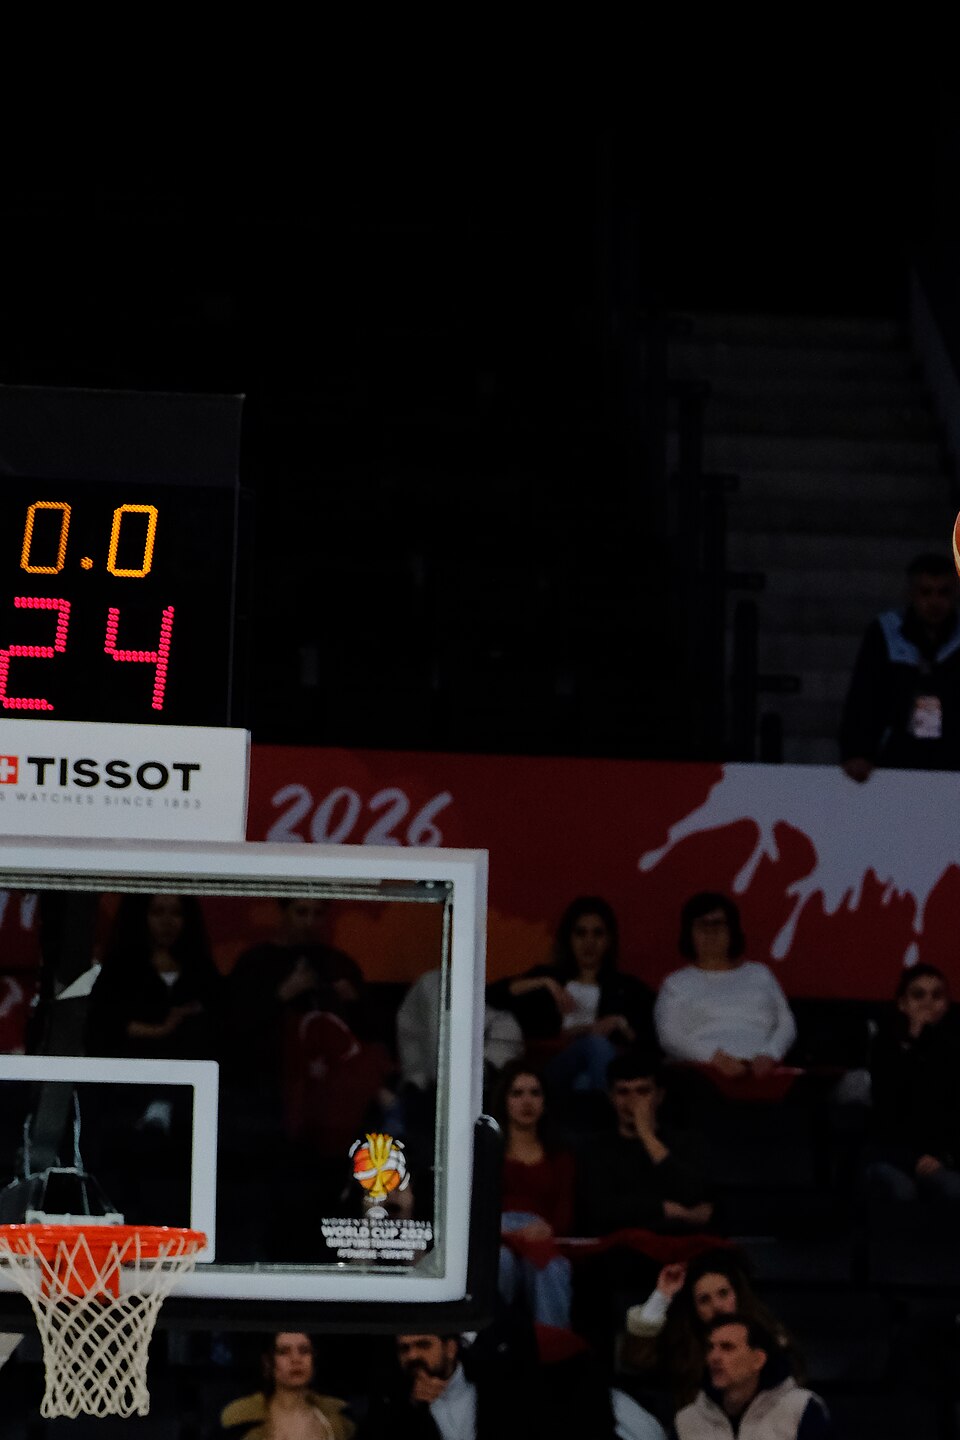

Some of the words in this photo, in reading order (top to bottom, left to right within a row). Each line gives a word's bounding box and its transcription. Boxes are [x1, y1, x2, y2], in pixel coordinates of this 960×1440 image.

[20, 501, 159, 577] 0.0
[0, 596, 175, 711] 24
[16, 792, 94, 805] WATCHES
[104, 795, 154, 807] SINCE
[27, 756, 200, 791] TISSOT
[265, 783, 453, 848] 2026
